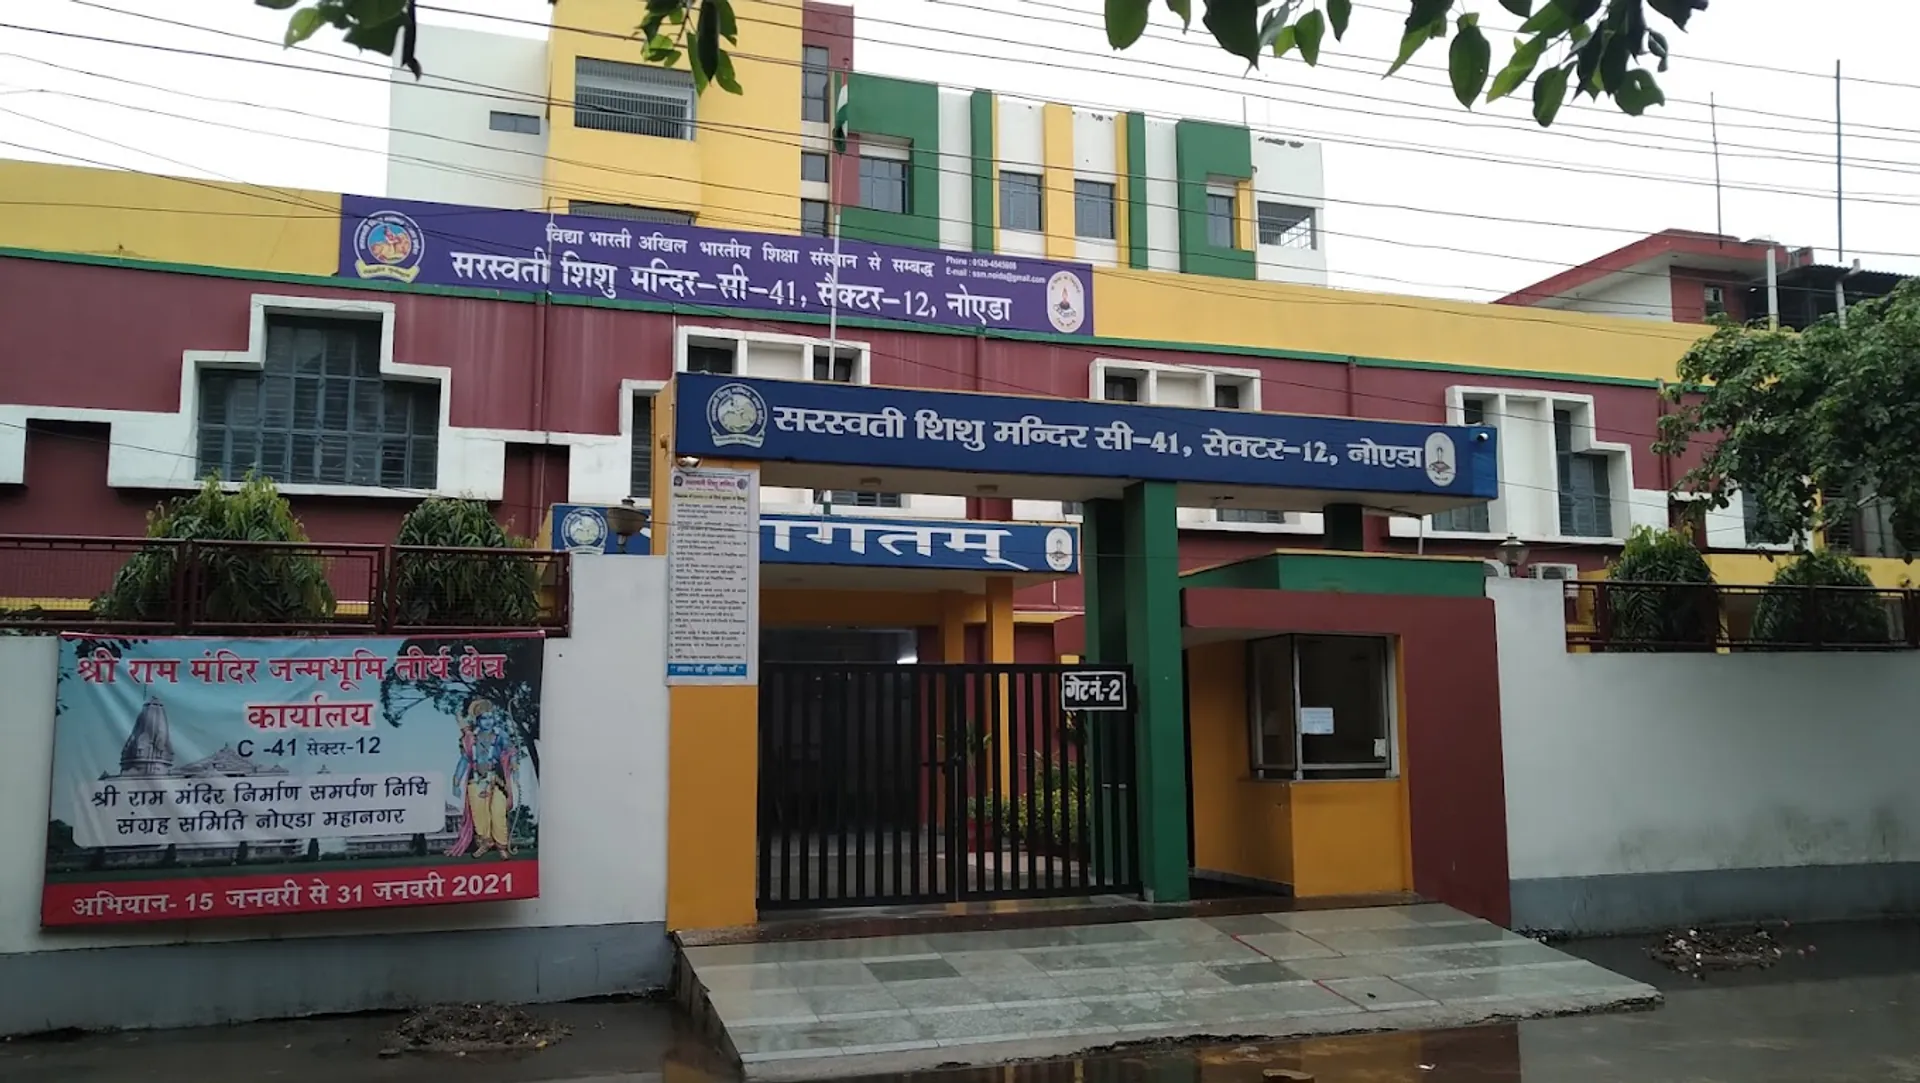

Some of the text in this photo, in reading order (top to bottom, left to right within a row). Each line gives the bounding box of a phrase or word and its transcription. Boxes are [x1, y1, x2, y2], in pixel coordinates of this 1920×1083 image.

[588, 227, 632, 249] भारती
[638, 231, 688, 254] अखिल
[699, 237, 752, 260] भारतीय
[762, 242, 800, 264] शिक्षा
[867, 252, 882, 271] से
[945, 255, 967, 266] Phone
[450, 247, 549, 285] सरस्वती
[560, 250, 618, 299] शिशु
[945, 284, 1012, 325] नोएडा
[945, 268, 967, 277] E-mail
[773, 406, 906, 438] सरस्वती
[914, 409, 985, 451] शिशु
[993, 414, 1087, 450] मन्दिर
[1346, 437, 1423, 468] नोएडा
[77, 645, 507, 691] श्री राम मंदिर जन्मभूमि तीर्थ क्षेत्र
[248, 695, 373, 728] कार्यालय
[238, 739, 254, 757] C
[306, 736, 381, 756] सेक्टर-12
[92, 776, 431, 807] श्री राम मंदिर निर्माण समर्पण निधि
[116, 808, 406, 835] संग्रह समिति नोएडा महानगर
[185, 892, 214, 912] 15
[226, 880, 302, 908] जनवरी
[308, 879, 330, 905] से
[337, 885, 363, 904] 31
[372, 871, 445, 899] जनवरी
[451, 872, 513, 898] 2021
